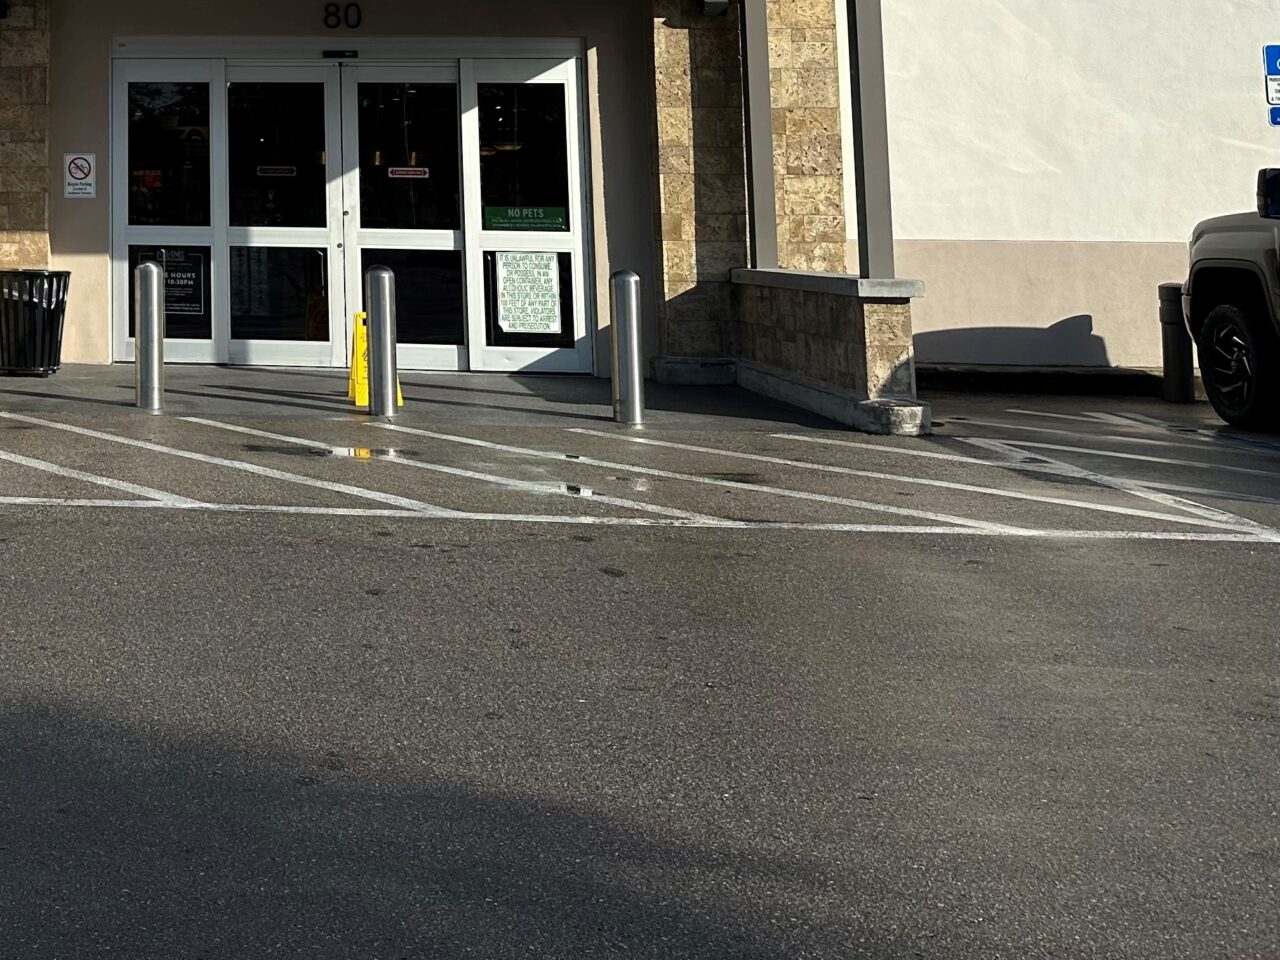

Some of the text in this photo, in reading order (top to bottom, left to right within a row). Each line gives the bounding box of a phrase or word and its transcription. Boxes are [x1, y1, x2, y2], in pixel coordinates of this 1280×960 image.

[324, 2, 361, 29] 80
[508, 209, 544, 218] NO PETS
